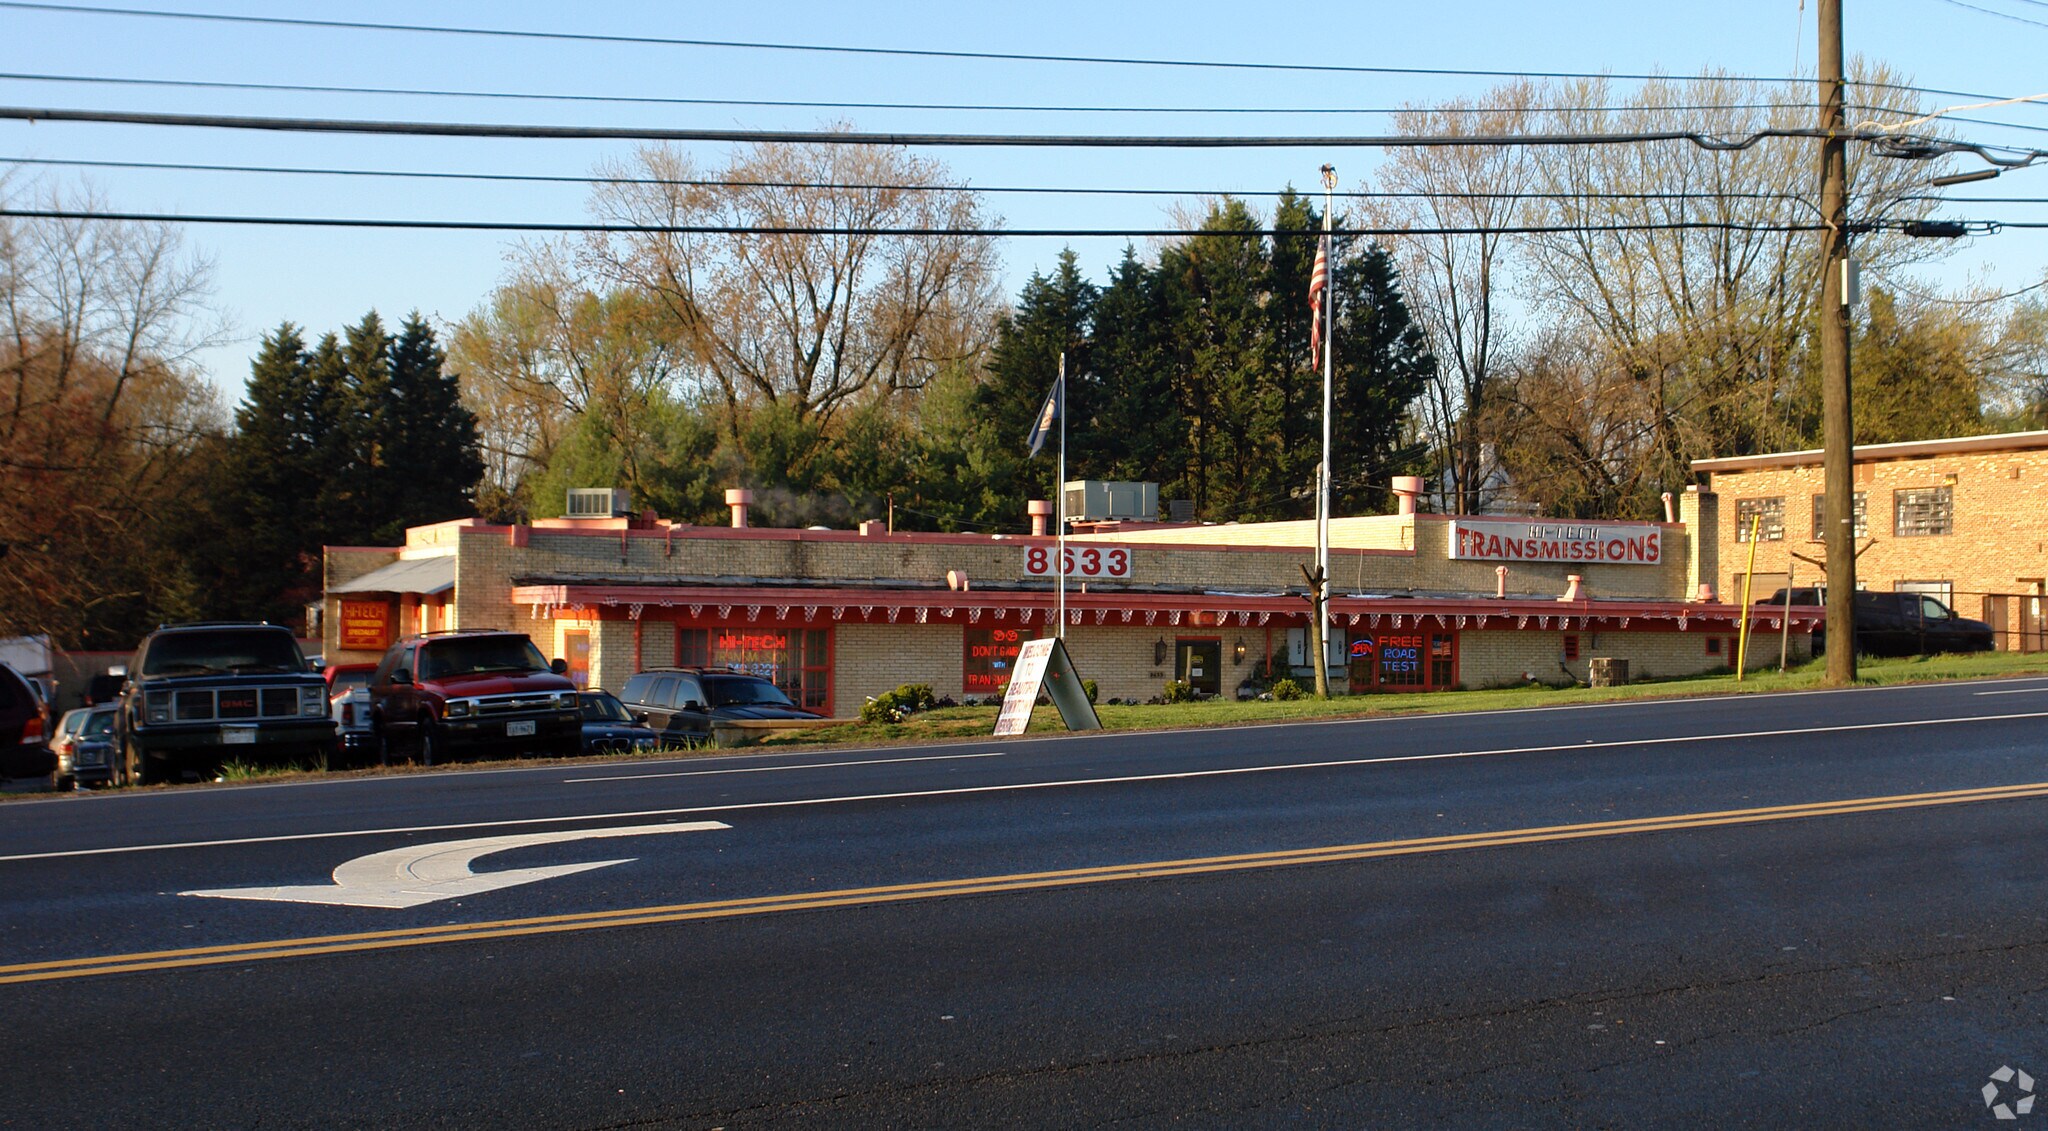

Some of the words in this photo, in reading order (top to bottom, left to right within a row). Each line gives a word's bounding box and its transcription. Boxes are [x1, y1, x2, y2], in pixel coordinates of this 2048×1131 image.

[1529, 525, 1599, 540] HI-TECH
[1456, 527, 1659, 562] TRANSMISSIONS
[1027, 547, 1128, 576] 8633
[719, 635, 786, 650] HI-TECH
[1379, 636, 1422, 647] FREE
[971, 645, 998, 657] DON'T
[999, 645, 1020, 657] GAMB
[1351, 643, 1373, 654] OPEN
[1384, 649, 1417, 659] ROAD
[992, 661, 1007, 669] WITH
[1382, 661, 1419, 672] TEST
[221, 701, 254, 709] GMC
